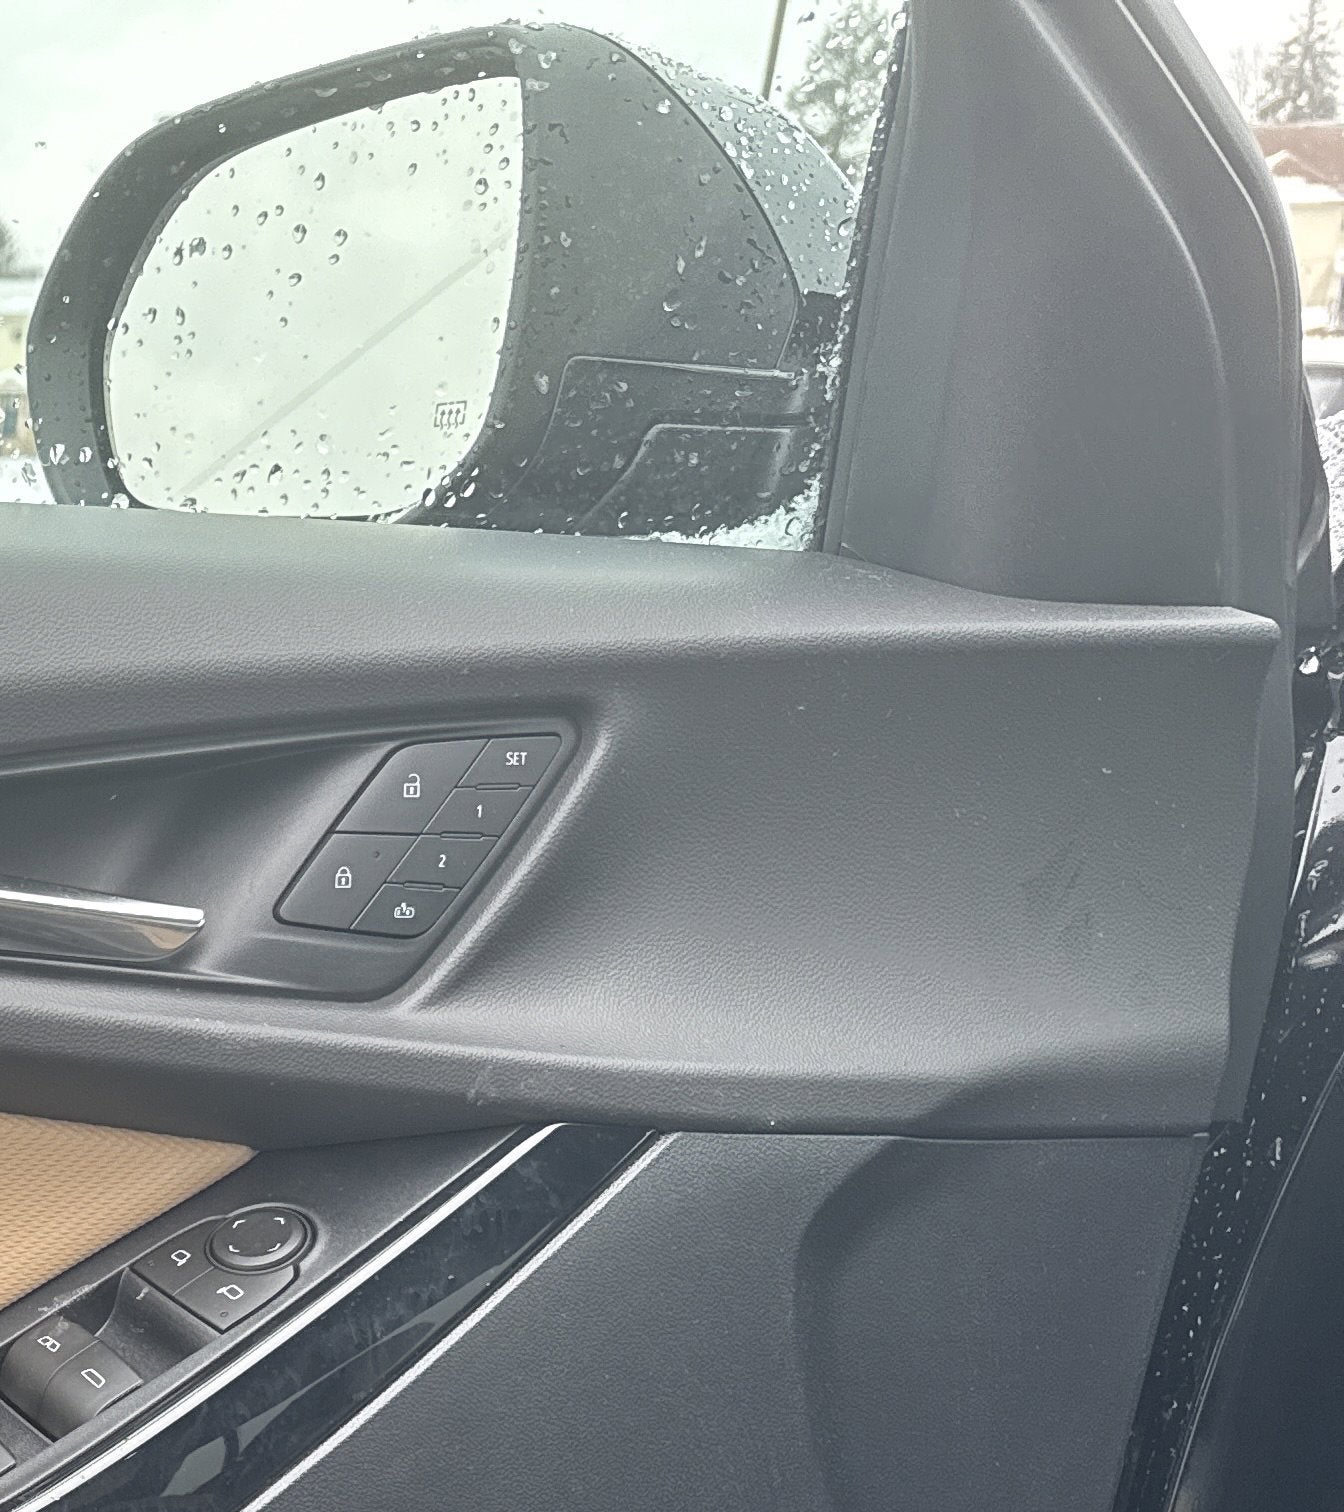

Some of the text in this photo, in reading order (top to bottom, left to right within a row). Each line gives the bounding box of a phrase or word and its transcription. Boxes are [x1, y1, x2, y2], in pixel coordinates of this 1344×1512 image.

[505, 752, 527, 766] SET
[476, 804, 483, 818] 1
[438, 854, 447, 868] 2
